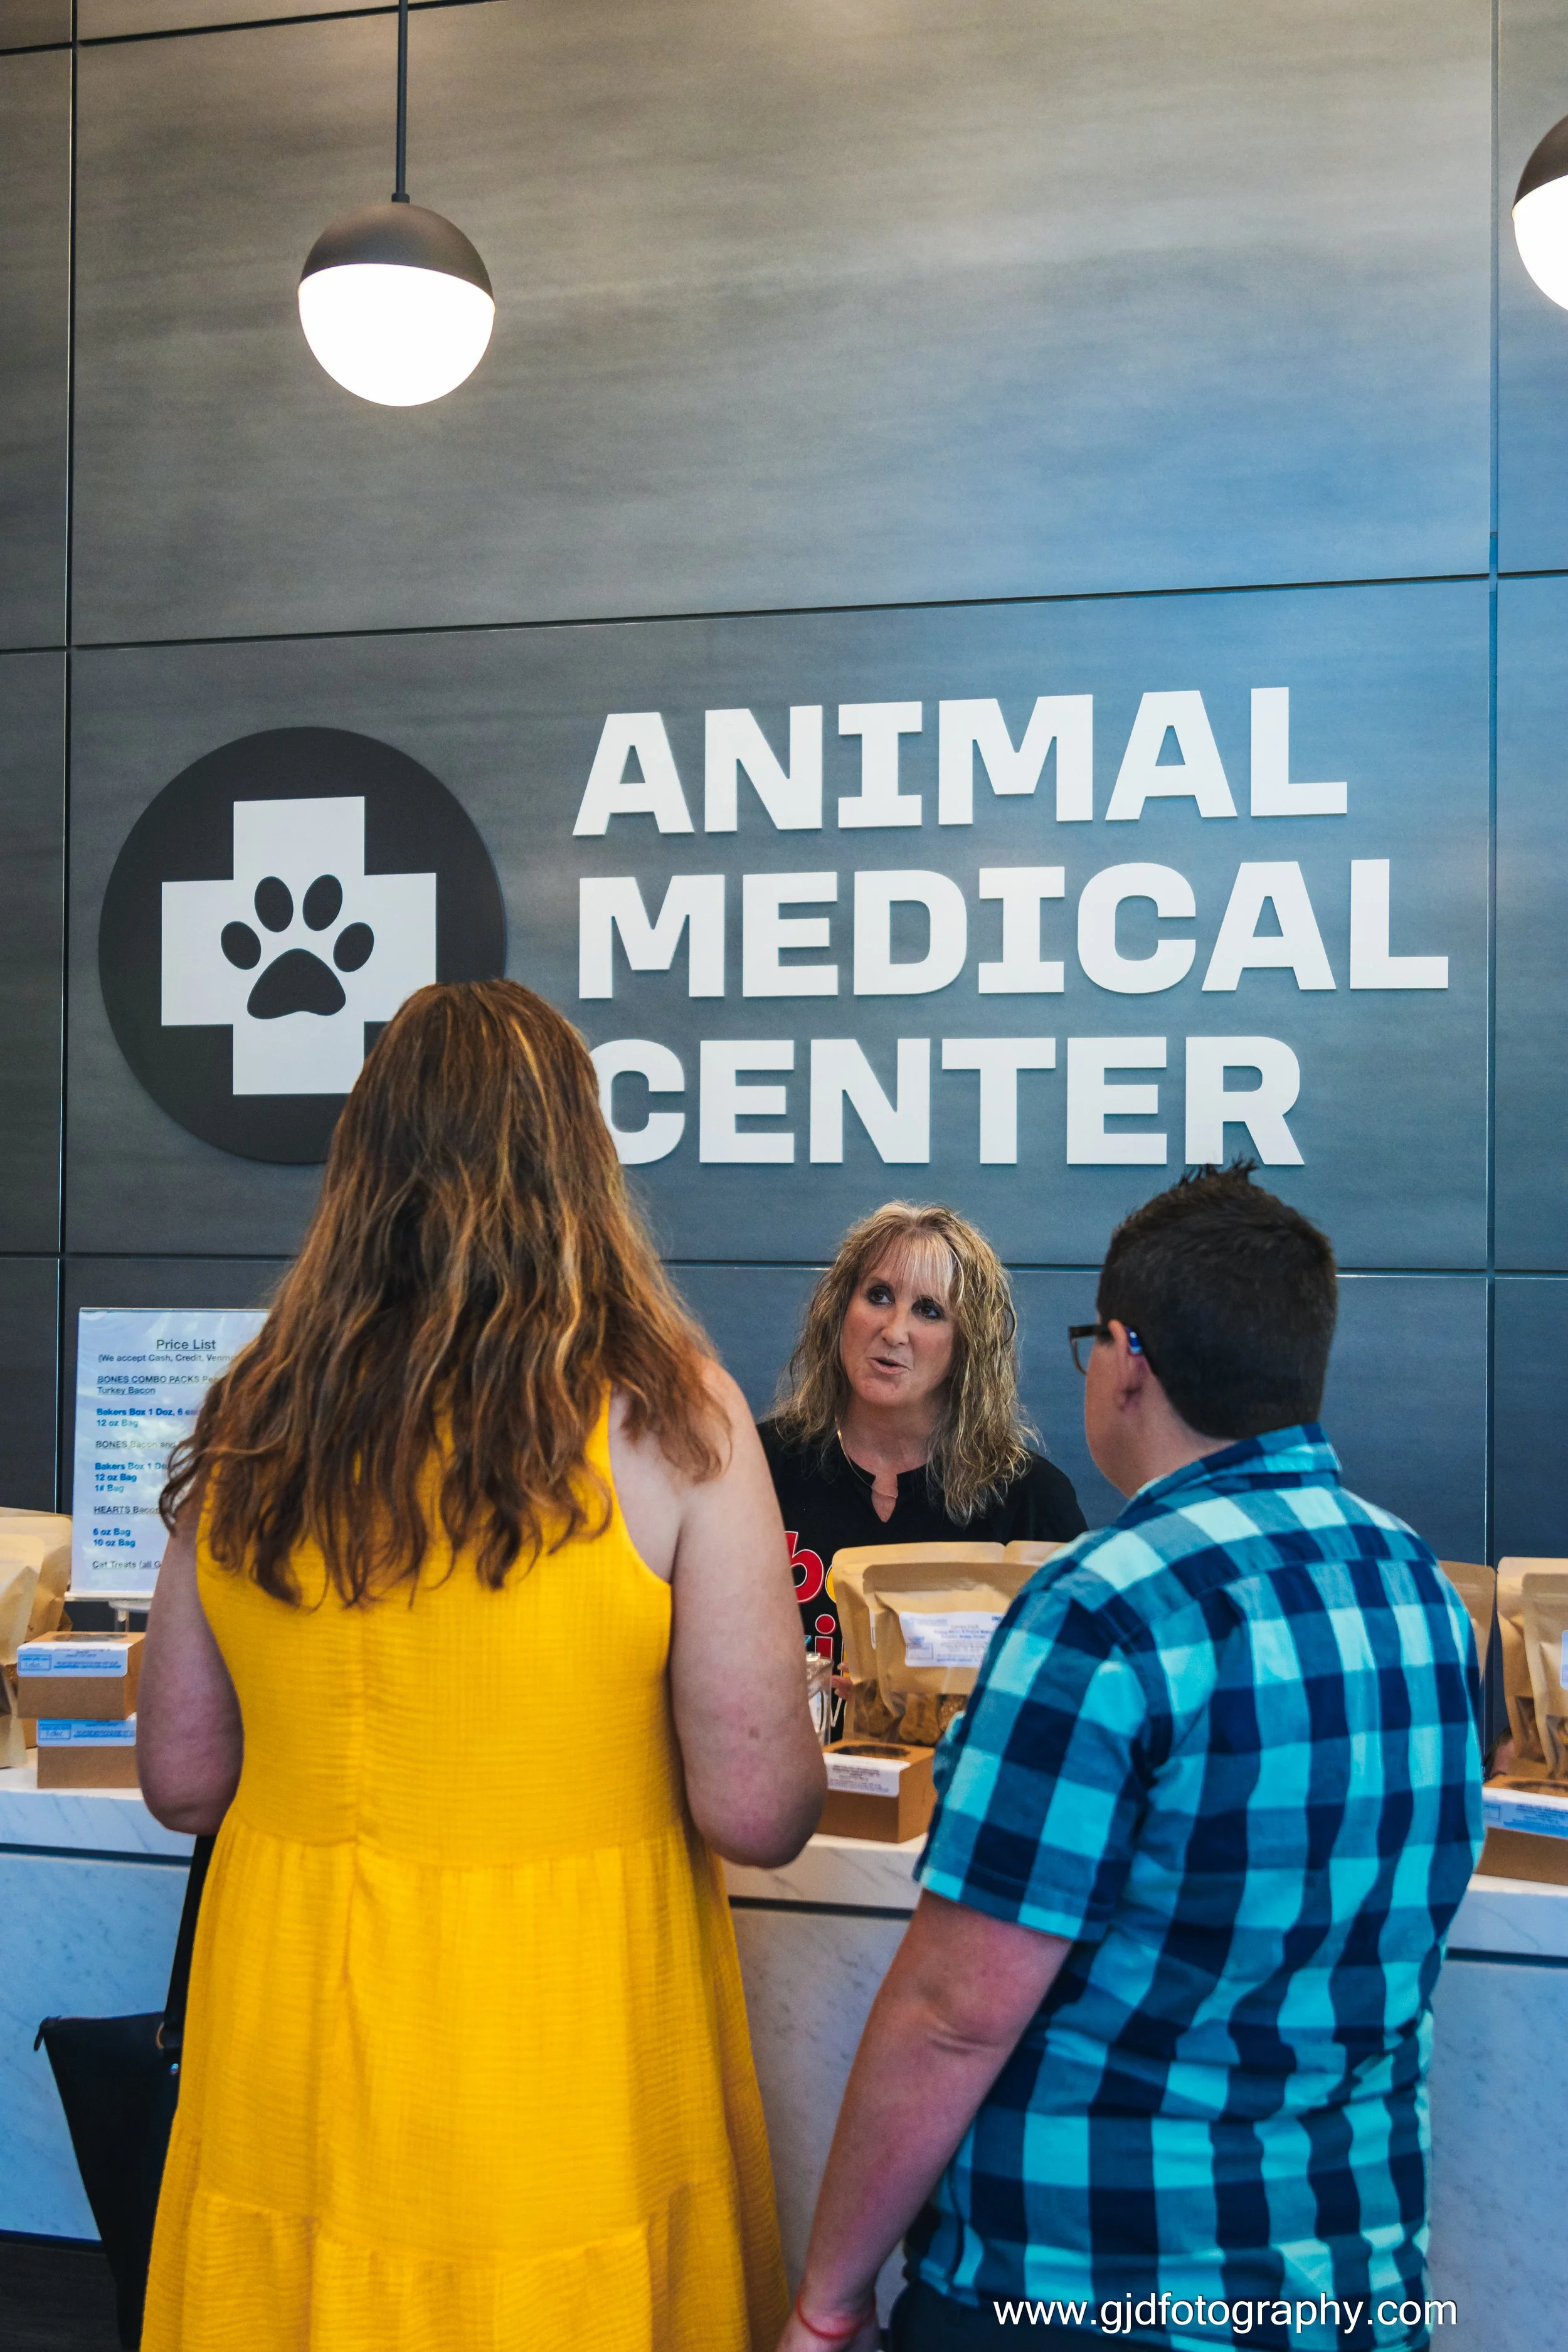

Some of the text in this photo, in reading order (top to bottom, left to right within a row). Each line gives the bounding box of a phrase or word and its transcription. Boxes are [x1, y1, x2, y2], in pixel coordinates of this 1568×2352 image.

[573, 686, 1348, 836] ANIMAL
[578, 859, 1449, 999] MEDICAL
[590, 1036, 1305, 1165] CENTER
[156, 1339, 216, 1350] Price List
[98, 1354, 114, 1362] (We
[149, 1354, 173, 1362] Cash,
[98, 1387, 127, 1395] Turkey
[156, 1408, 176, 1416] Doz,
[122, 1419, 139, 1428] Bag
[120, 1473, 137, 1482] Bag
[107, 1485, 124, 1493] Bag
[114, 1528, 131, 1537] Bag
[118, 1539, 136, 1548] Bag
